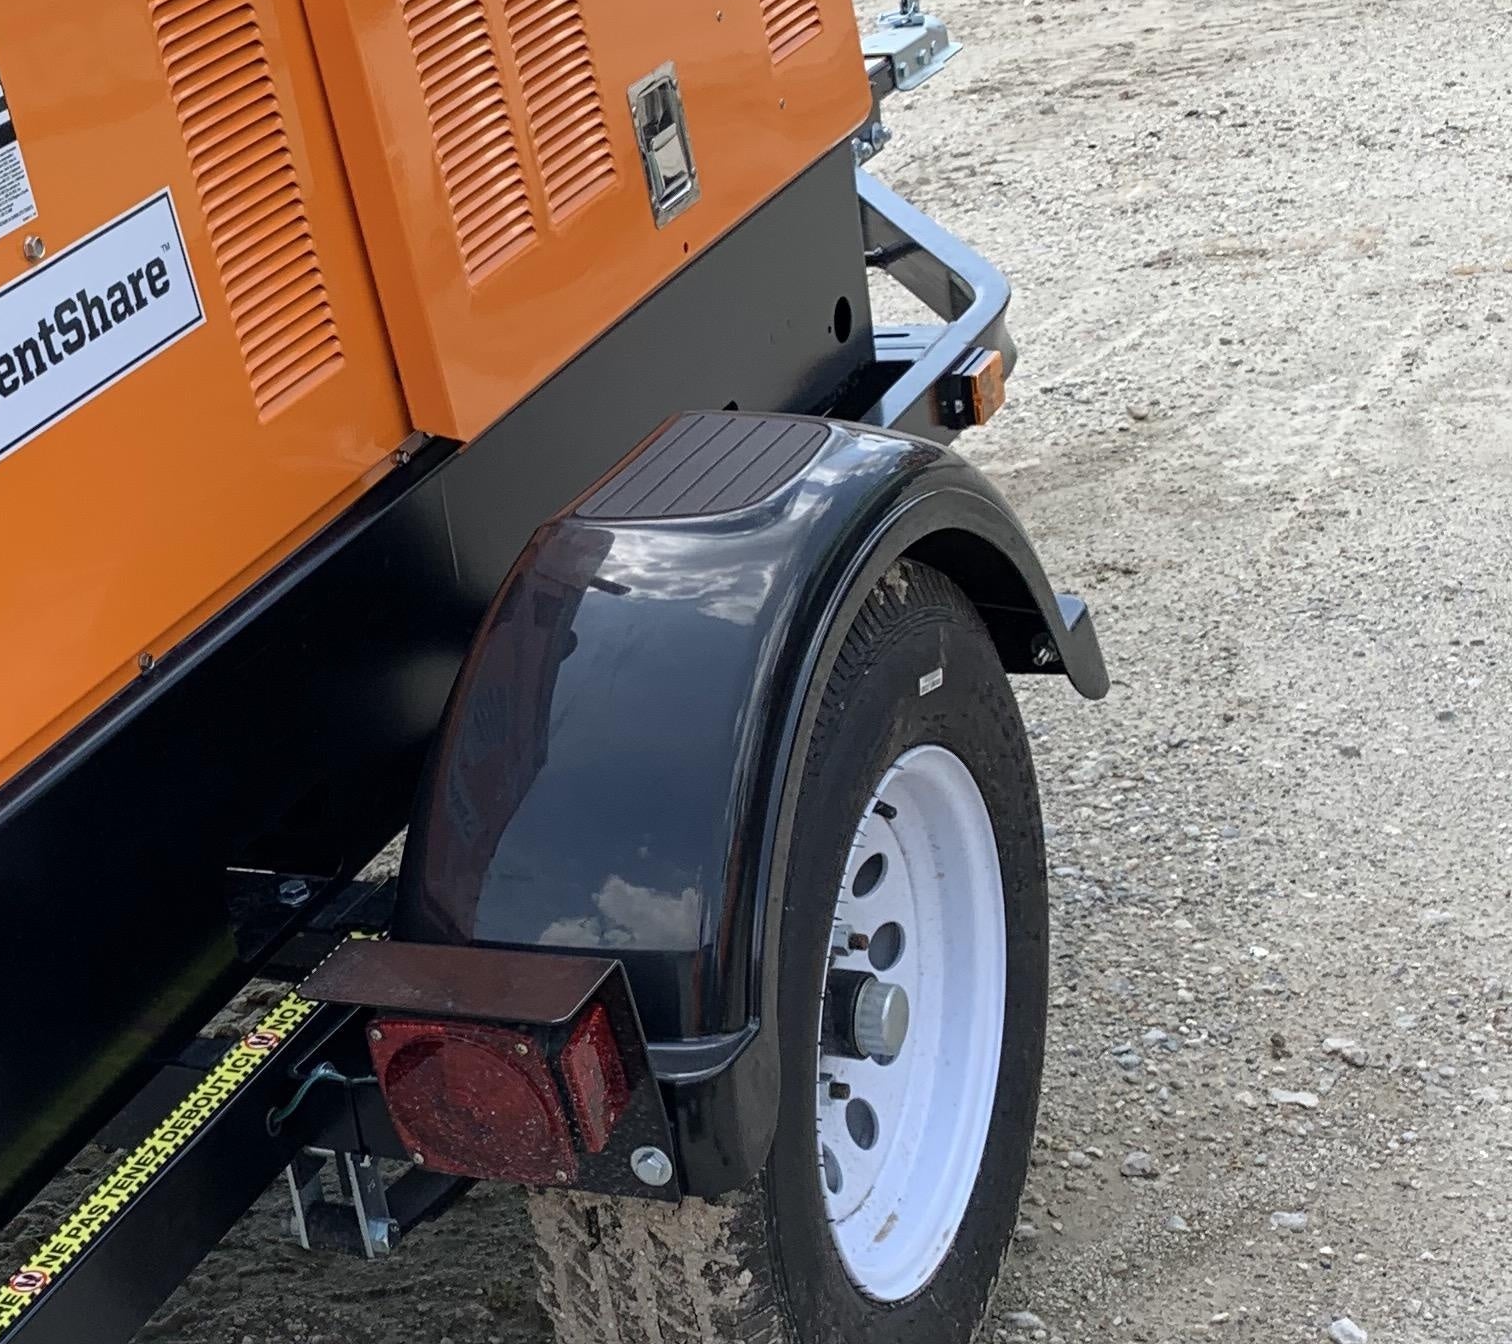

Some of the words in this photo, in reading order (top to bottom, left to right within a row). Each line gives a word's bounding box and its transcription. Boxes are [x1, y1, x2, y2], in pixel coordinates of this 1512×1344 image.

[267, 1008, 300, 1030] NO
[37, 1241, 73, 1268] NE
[67, 1204, 106, 1240] PAS
[100, 1146, 167, 1200] TENEZ
[158, 1075, 232, 1143] DEBOUT
[225, 1052, 258, 1074] ICI
